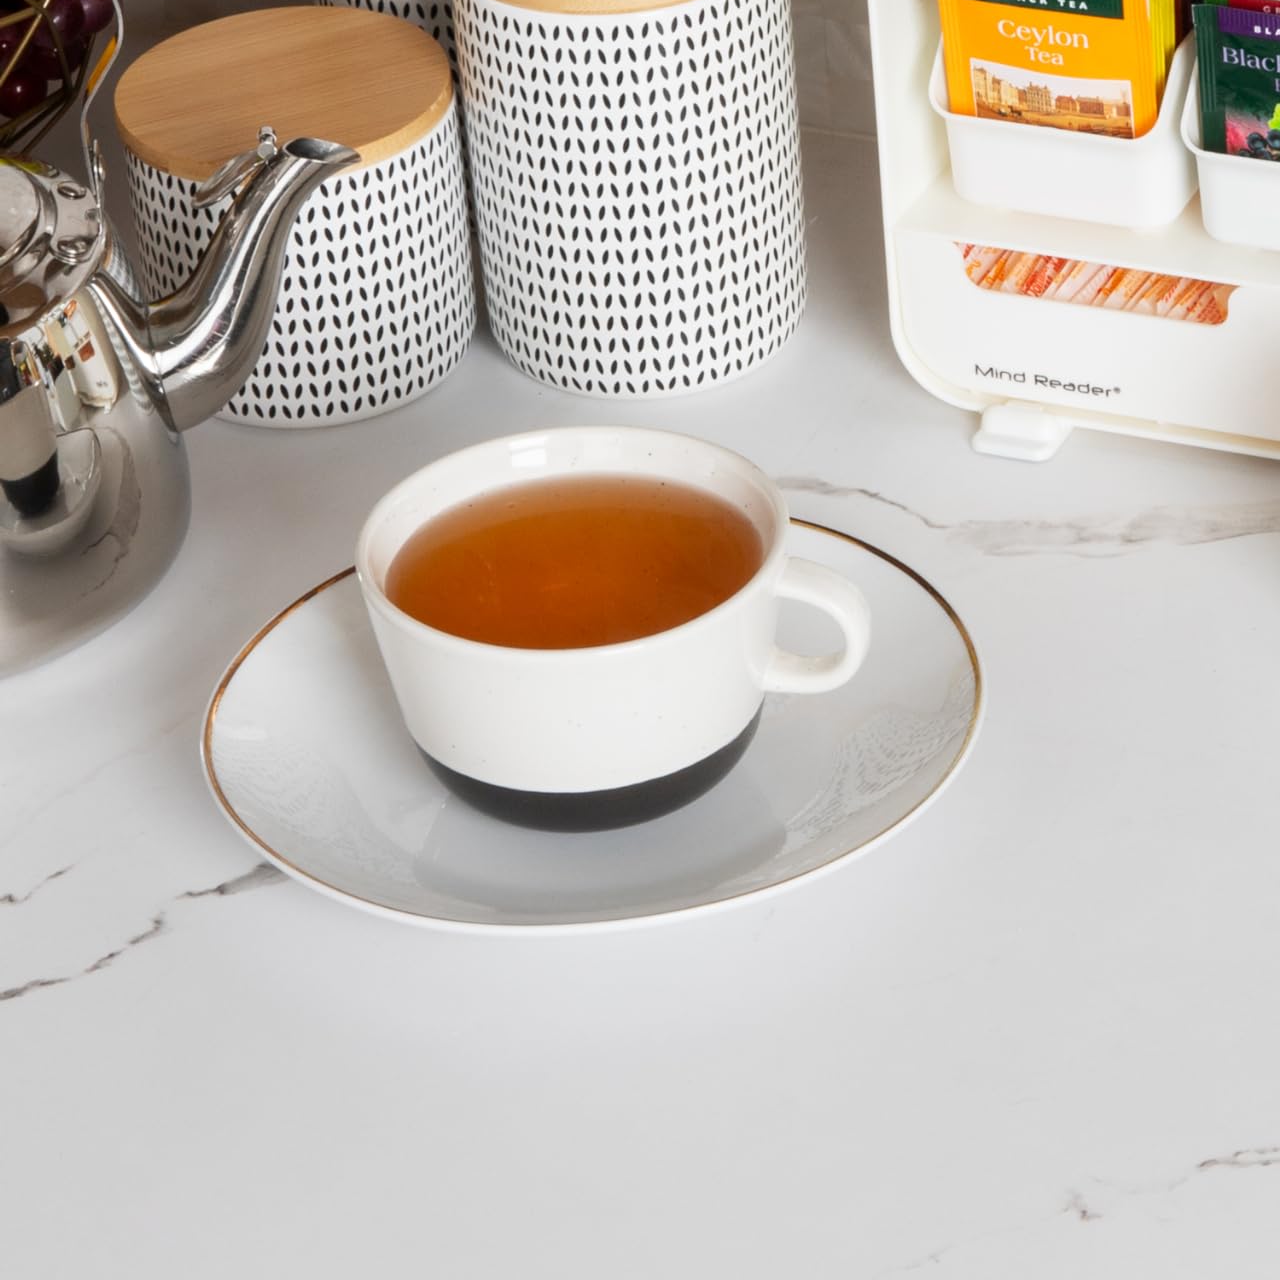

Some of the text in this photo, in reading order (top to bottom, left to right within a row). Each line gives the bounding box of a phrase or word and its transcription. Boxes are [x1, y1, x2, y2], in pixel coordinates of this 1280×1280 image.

[1057, 0, 1089, 10] TEA
[997, 19, 1089, 49] Ceylon
[1025, 46, 1064, 66] Tea
[974, 364, 1026, 383] Mind
